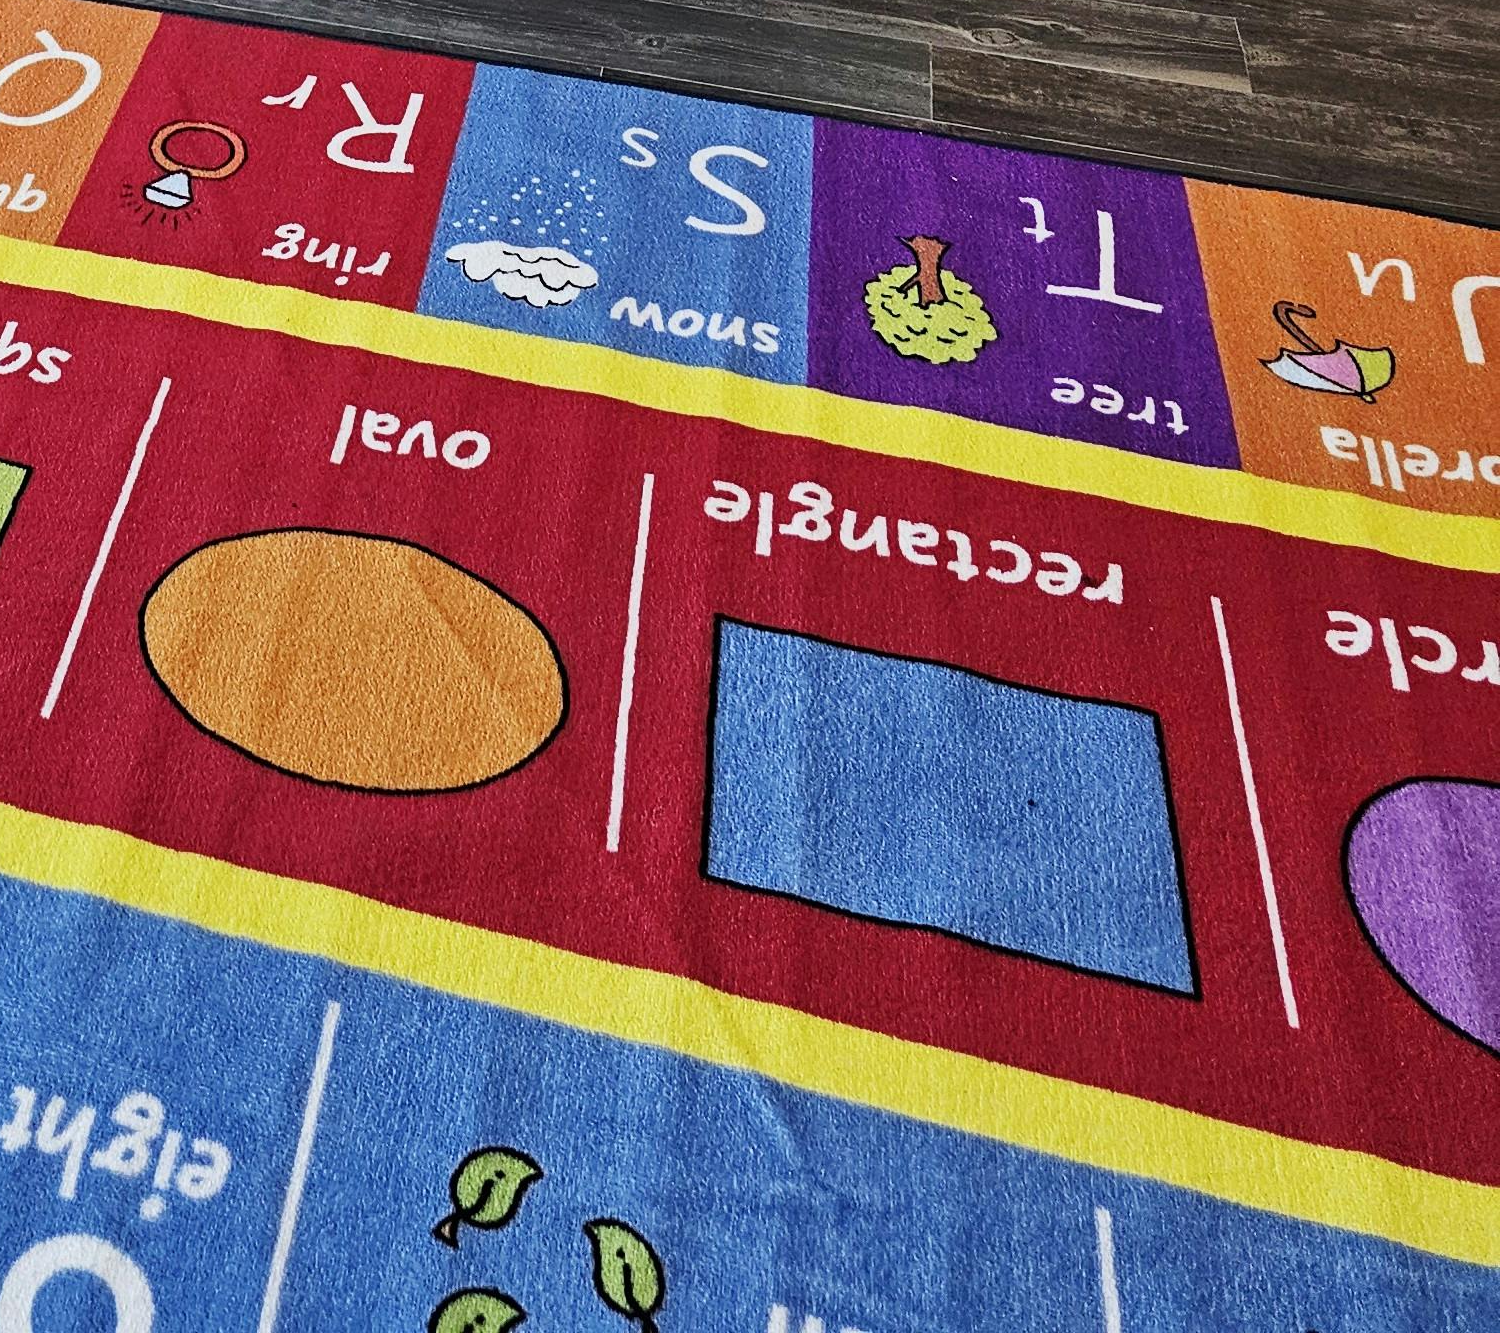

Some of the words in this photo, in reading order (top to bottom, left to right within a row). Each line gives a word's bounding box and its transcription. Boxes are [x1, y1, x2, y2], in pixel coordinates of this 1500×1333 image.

[262, 222, 393, 287] ring
[611, 297, 779, 353] snow
[331, 405, 490, 469] oval
[1051, 378, 1188, 435] tree
[705, 481, 1123, 604] rectangle
[1326, 611, 1500, 691] rcle
